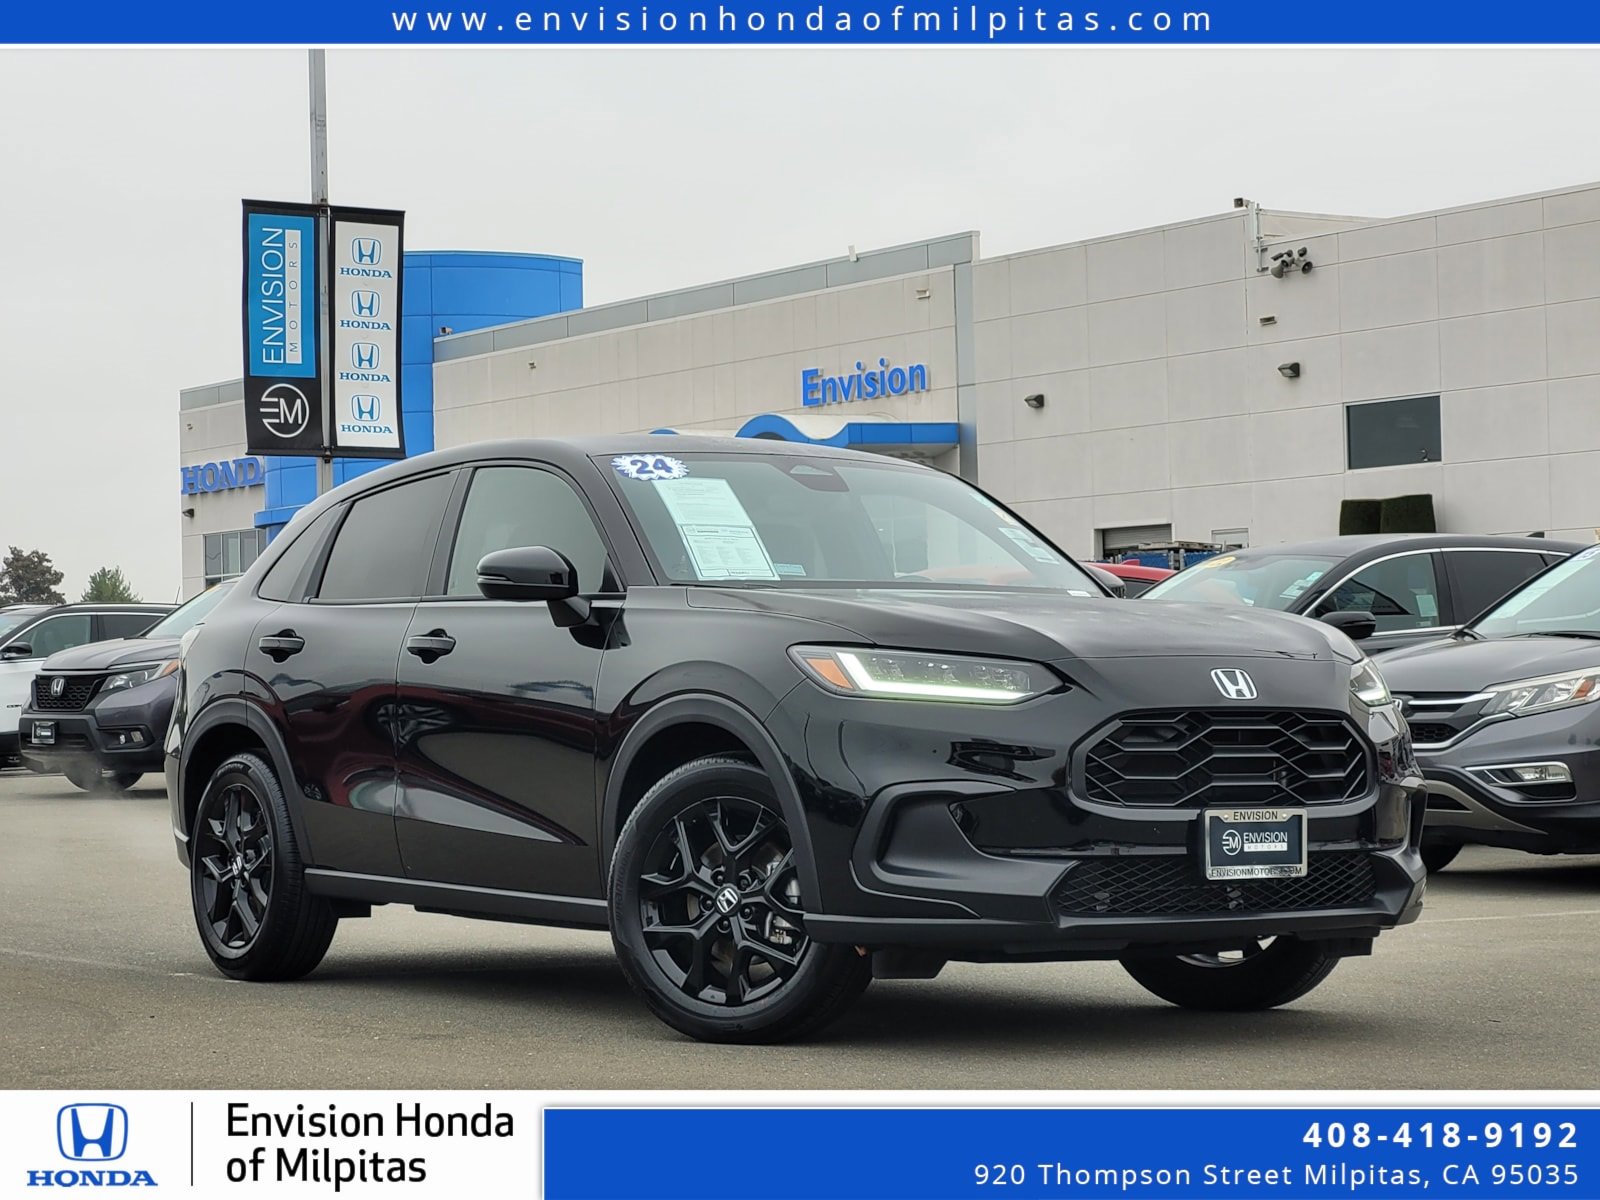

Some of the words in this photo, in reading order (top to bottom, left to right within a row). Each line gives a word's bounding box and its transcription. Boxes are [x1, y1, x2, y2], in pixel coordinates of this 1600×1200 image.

[339, 267, 393, 279] HONDA
[261, 227, 284, 365] ENVISION
[288, 240, 298, 353] MOTORS
[339, 319, 392, 331] HONDA
[338, 372, 392, 383] HONDA
[802, 357, 927, 408] Envision
[341, 424, 394, 435] HONDA
[630, 458, 673, 475] 24
[181, 457, 264, 495] HOND
[1233, 811, 1278, 821] ENVISION
[1243, 831, 1288, 843] ENVISION
